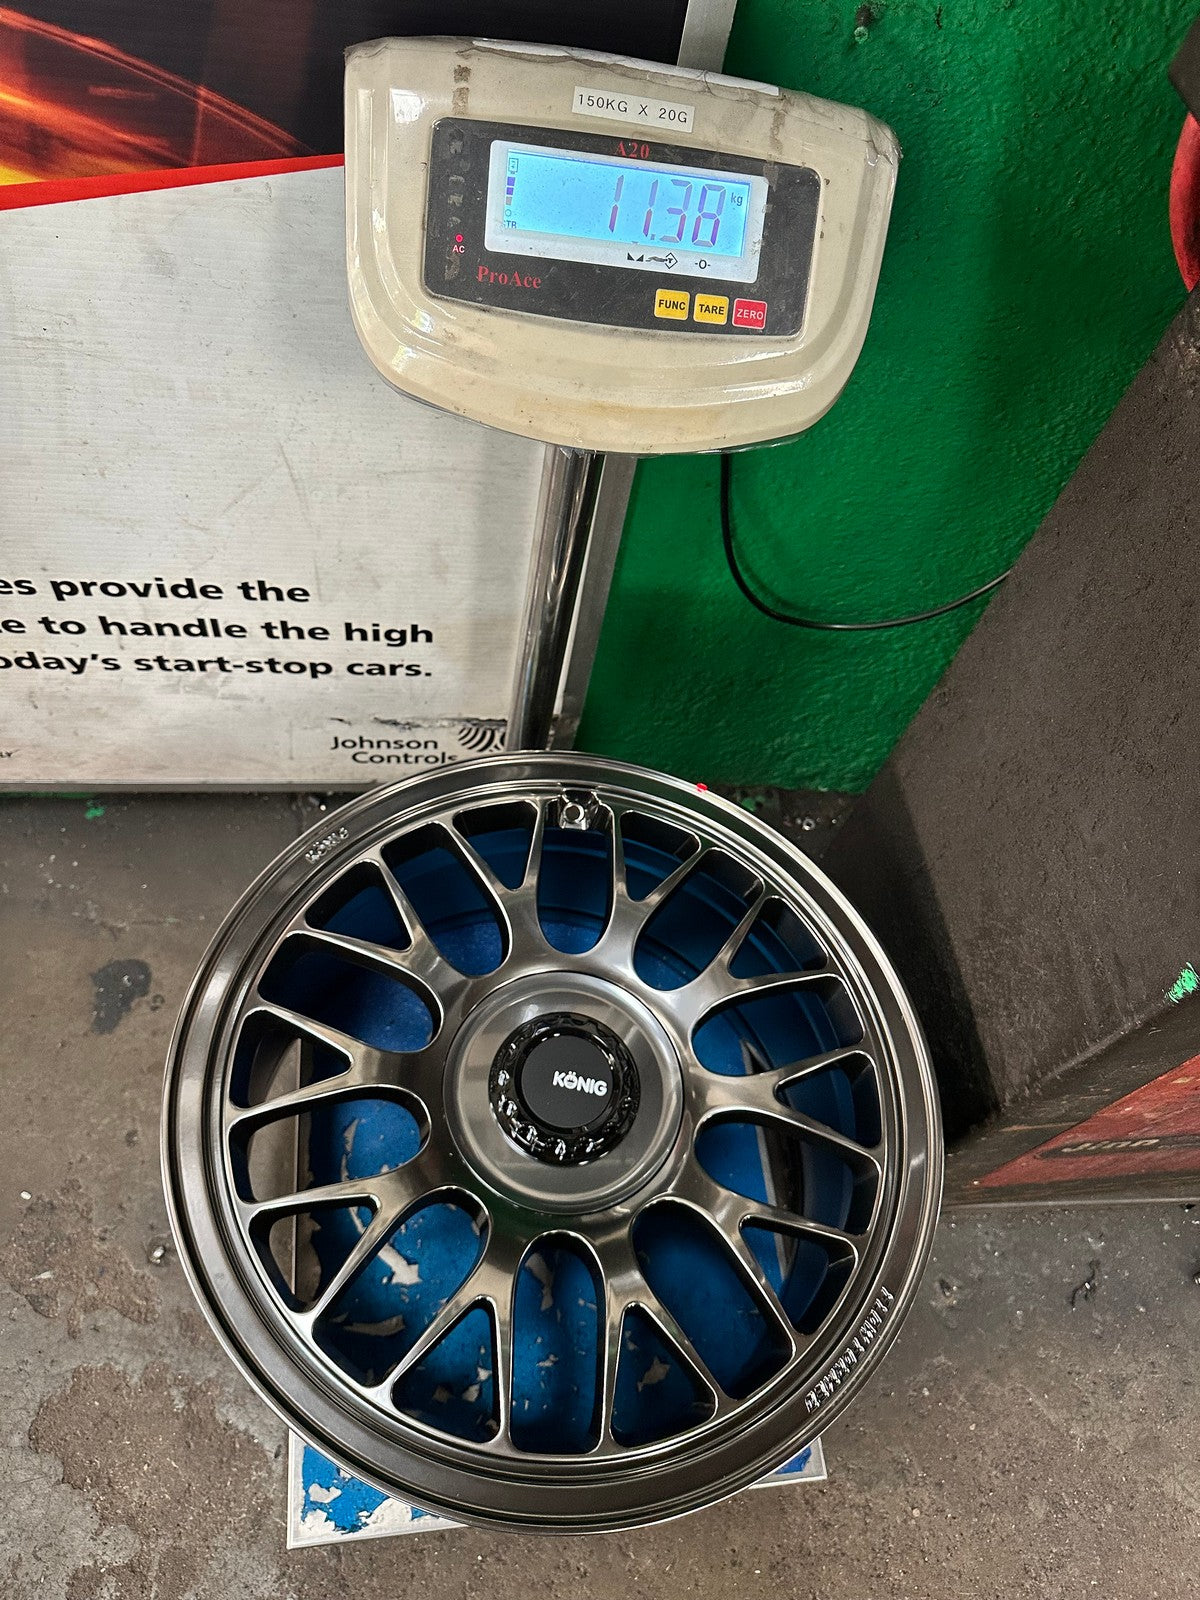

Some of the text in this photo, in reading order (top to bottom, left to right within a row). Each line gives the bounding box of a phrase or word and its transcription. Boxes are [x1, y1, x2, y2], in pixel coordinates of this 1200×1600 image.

[578, 93, 689, 124] 150KG X 20G
[613, 140, 650, 159] A20
[607, 174, 745, 249] 11.38 kg
[452, 243, 466, 254] AC
[476, 264, 542, 290] ProAce
[658, 298, 687, 312] FUNC
[698, 303, 726, 316] TARE
[736, 308, 765, 321] ZERO
[49, 577, 224, 602] provide
[236, 580, 311, 603] the
[0, 616, 434, 648] e to handle the high
[134, 654, 334, 679] start-stop
[346, 660, 432, 678] cars.
[330, 735, 439, 751] Johnson
[552, 1070, 608, 1097] KÖNIG
